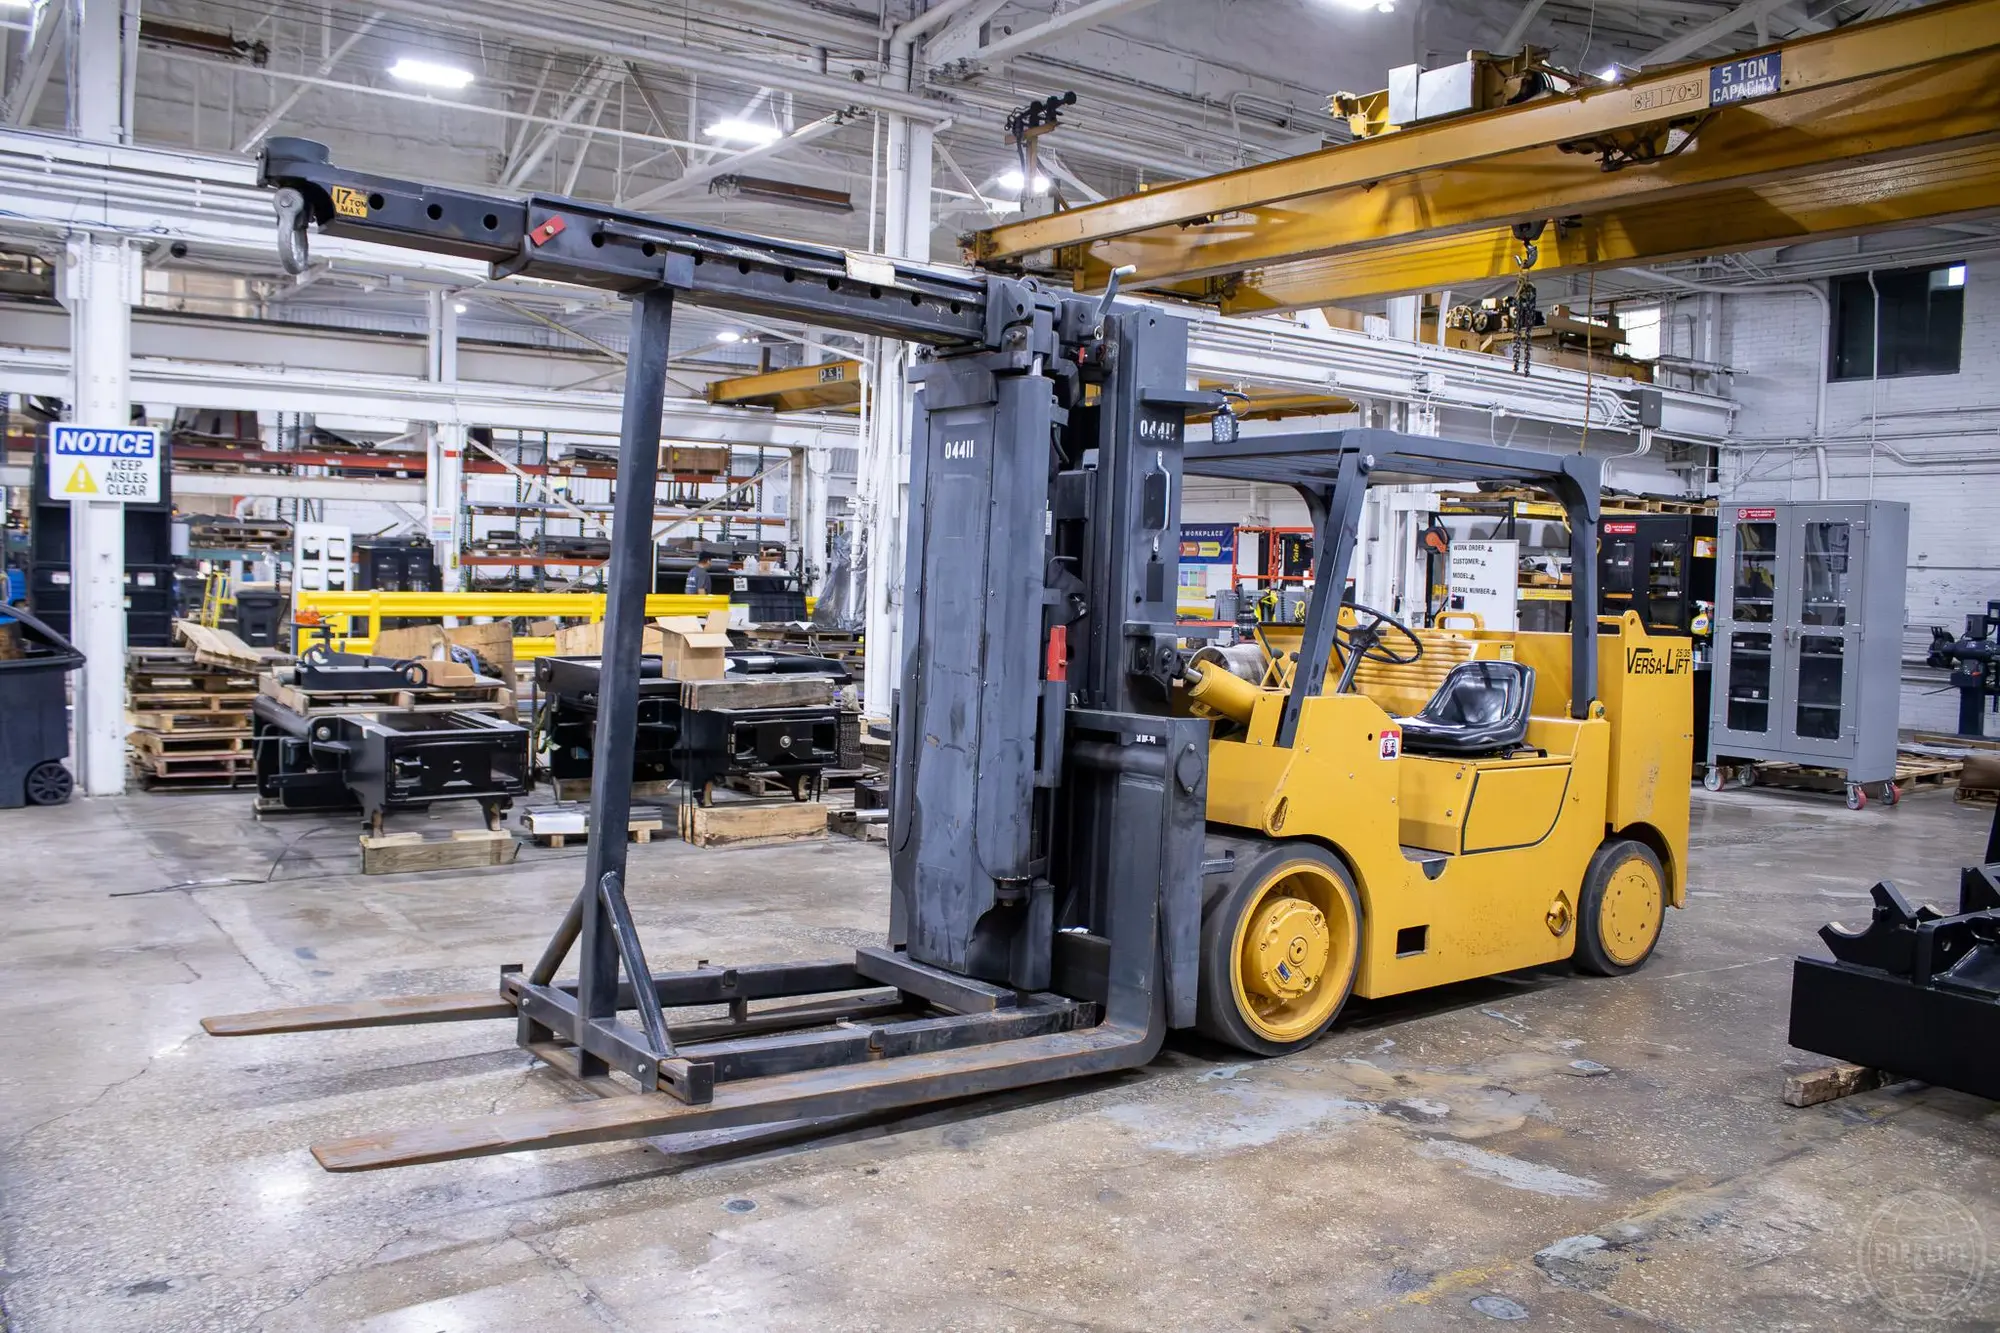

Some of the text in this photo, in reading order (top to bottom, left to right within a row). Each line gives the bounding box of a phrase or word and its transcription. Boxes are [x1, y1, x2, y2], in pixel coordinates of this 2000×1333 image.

[1721, 57, 1769, 84] 5 TON
[1712, 75, 1776, 103] CAPACITY
[336, 188, 367, 208] 17 TON
[340, 205, 361, 215] MAX
[836, 366, 843, 380] H
[58, 430, 153, 455] NOTICE
[945, 439, 975, 460] 04411
[111, 459, 143, 471] KEEP
[105, 471, 148, 484] AISLES
[107, 484, 147, 496] CLEAR
[1292, 543, 1300, 563] Yale
[1451, 586, 1469, 594] SERIAL
